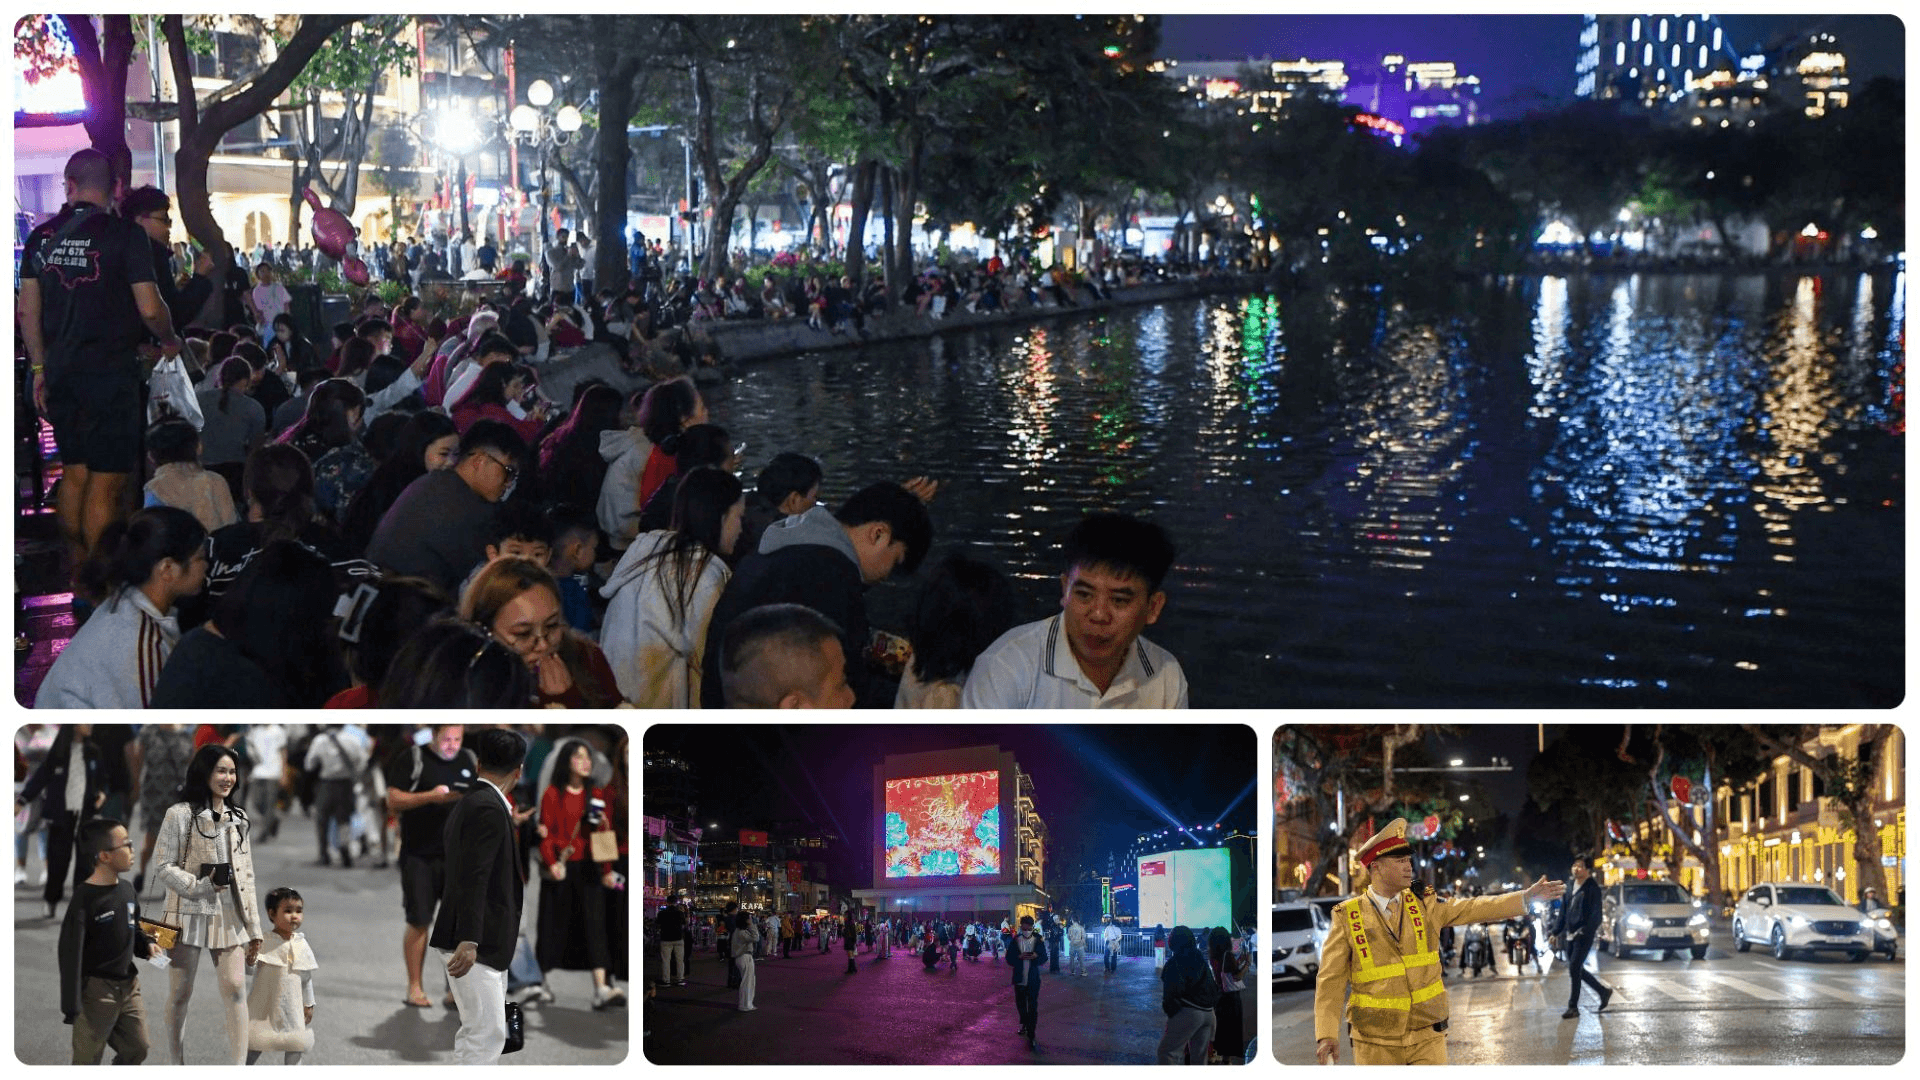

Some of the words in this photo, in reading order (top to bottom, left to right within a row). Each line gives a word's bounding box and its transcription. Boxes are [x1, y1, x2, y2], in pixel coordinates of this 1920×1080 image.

[60, 238, 91, 247] Around
[68, 247, 86, 256] 67K
[1405, 894, 1423, 940] CSGT
[1350, 910, 1368, 958] CSGT
